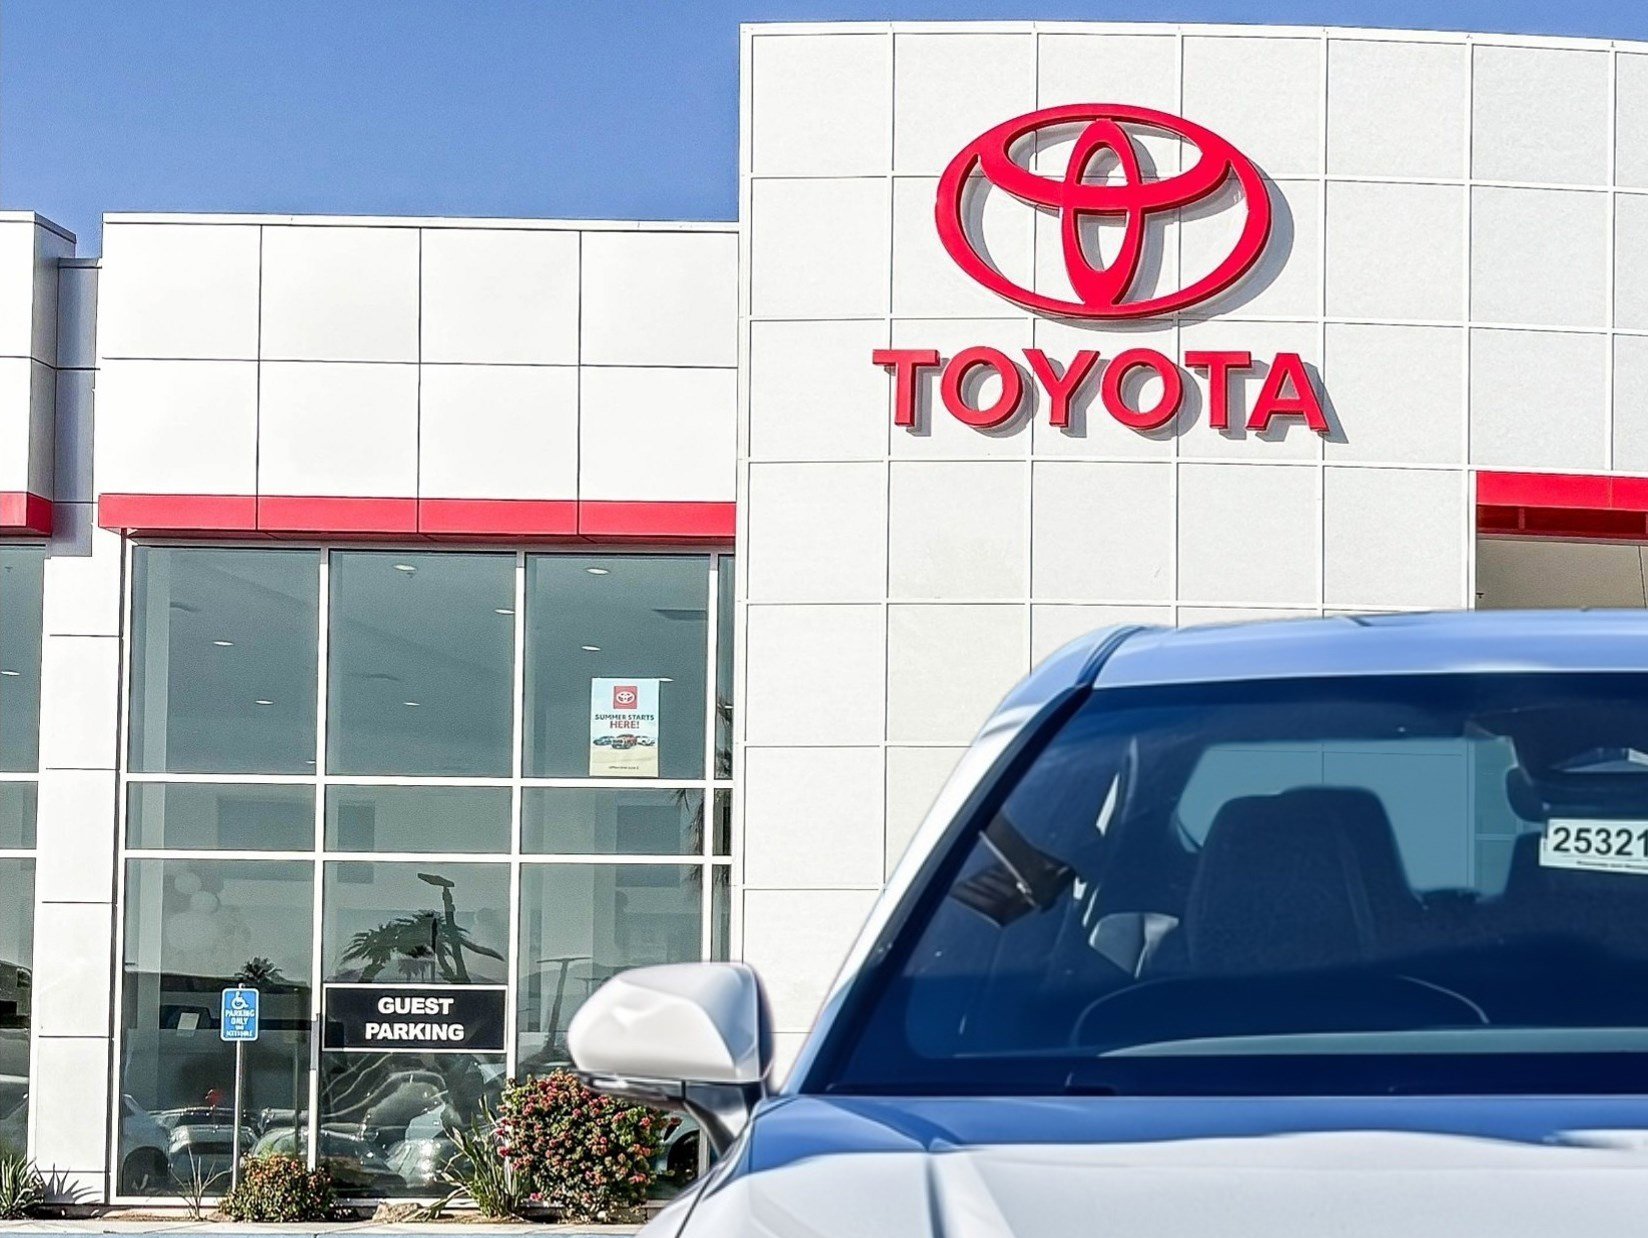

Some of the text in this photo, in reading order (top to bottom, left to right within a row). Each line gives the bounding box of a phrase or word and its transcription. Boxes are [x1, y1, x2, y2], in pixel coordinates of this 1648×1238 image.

[872, 345, 1330, 433] TOYOTA
[609, 720, 640, 729] HERE!
[377, 997, 454, 1015] GUEST
[225, 1009, 256, 1018] PARKING
[230, 1017, 249, 1025] ONLY
[364, 1022, 465, 1041] PARKING
